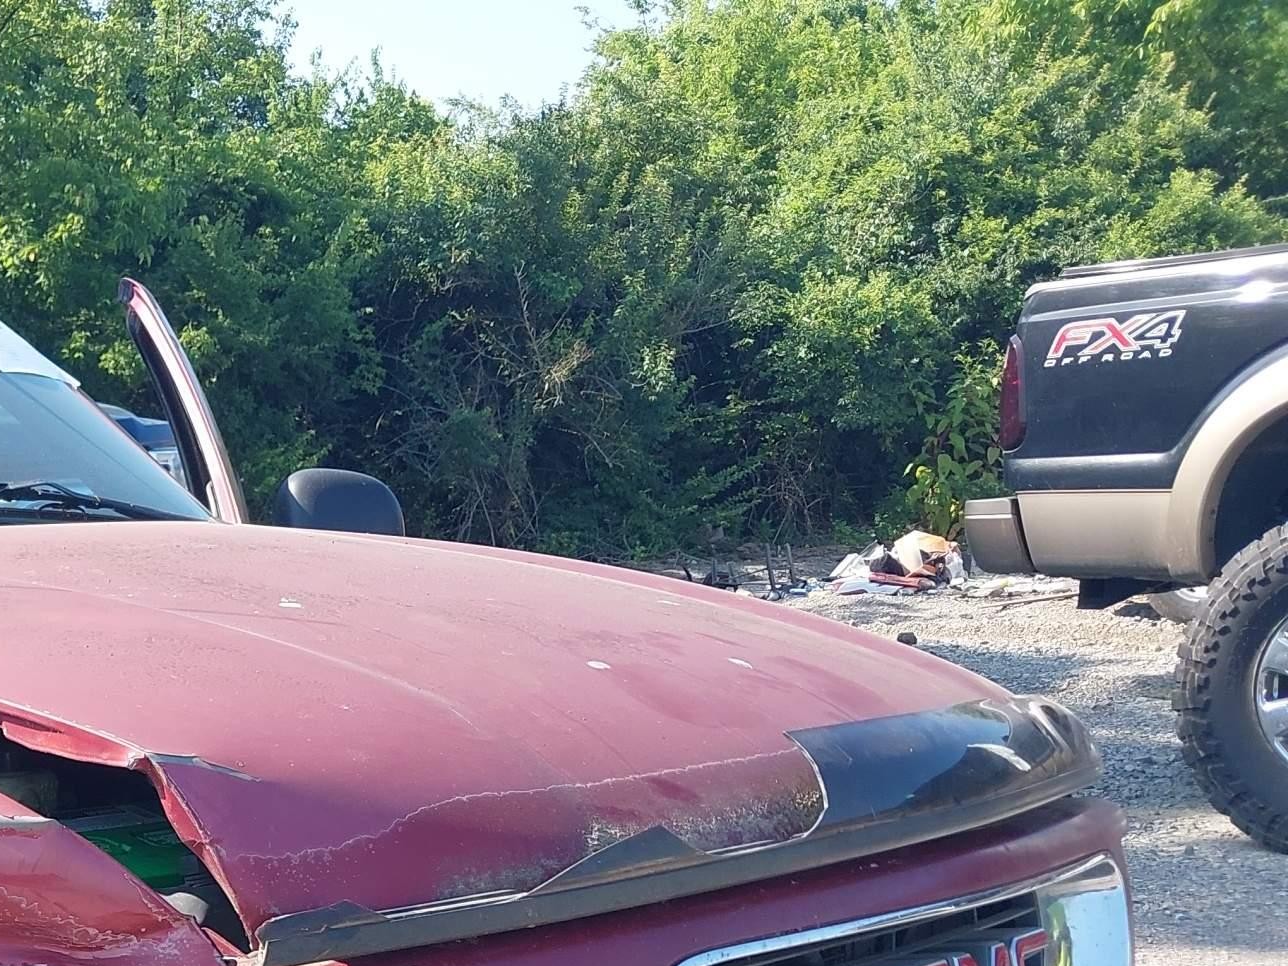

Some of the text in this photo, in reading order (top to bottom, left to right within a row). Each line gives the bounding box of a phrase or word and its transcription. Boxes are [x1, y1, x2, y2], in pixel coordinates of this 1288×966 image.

[1047, 309, 1187, 358] FX4
[1043, 349, 1173, 368] OFF ROAD
